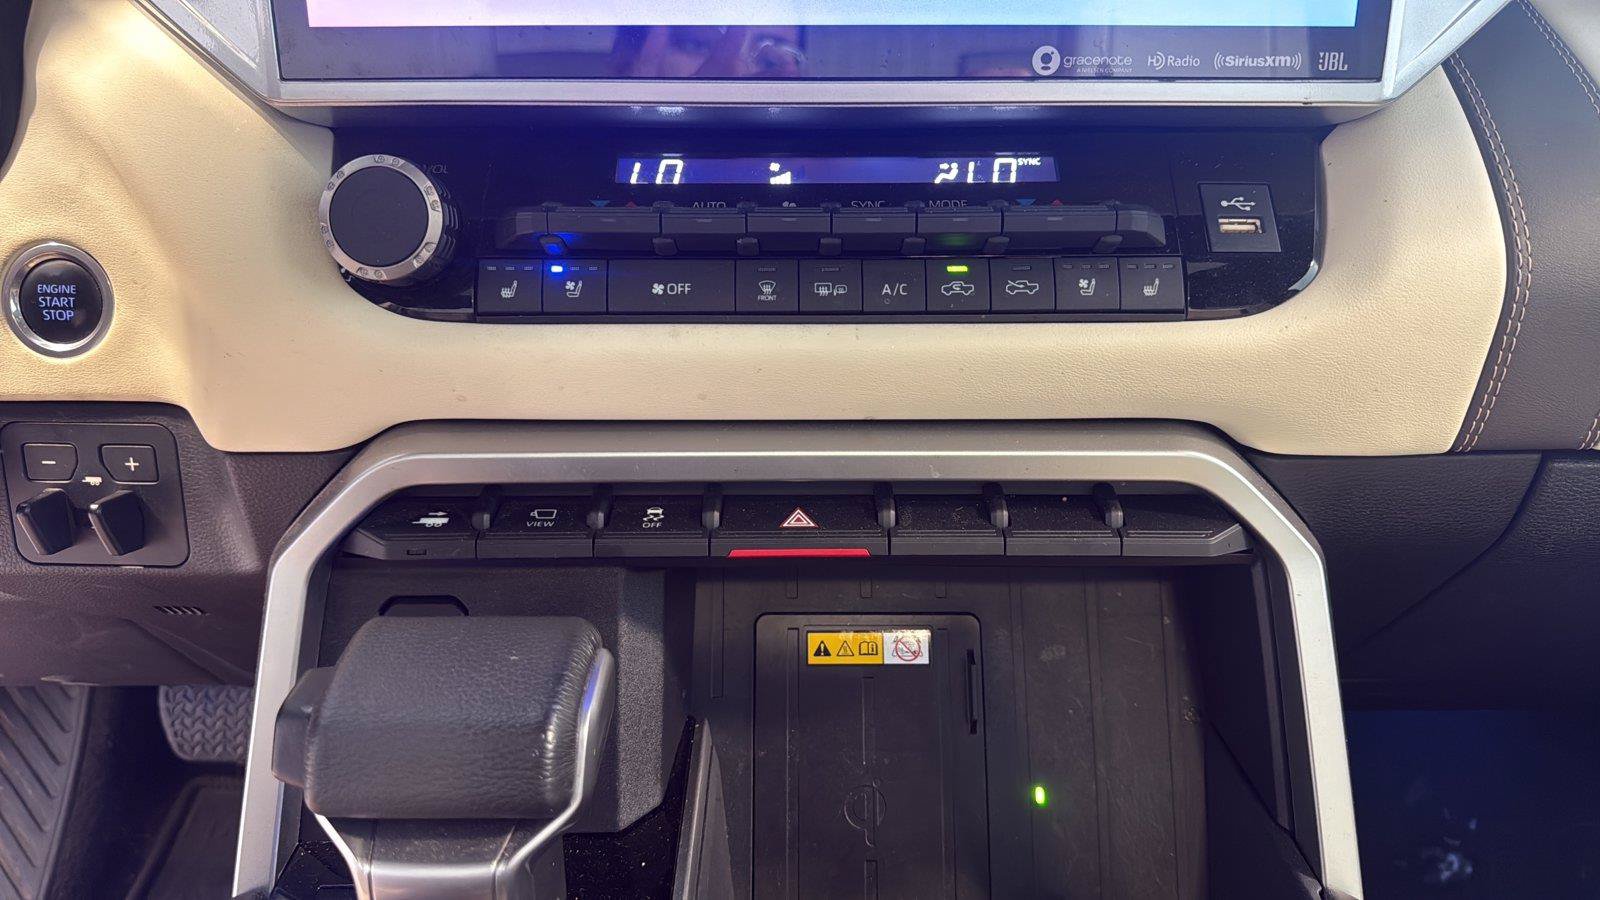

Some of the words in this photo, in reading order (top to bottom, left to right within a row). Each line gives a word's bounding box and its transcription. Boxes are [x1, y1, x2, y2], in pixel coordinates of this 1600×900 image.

[1063, 56, 1133, 68] gracenote
[1167, 54, 1200, 67] Radio
[1319, 52, 1348, 71] JBL
[1017, 157, 1042, 166] SYNC
[37, 284, 76, 294] ENGINE
[666, 283, 692, 295] OFF
[881, 283, 908, 296] A/C
[39, 296, 75, 308] START
[43, 309, 74, 321] STOP
